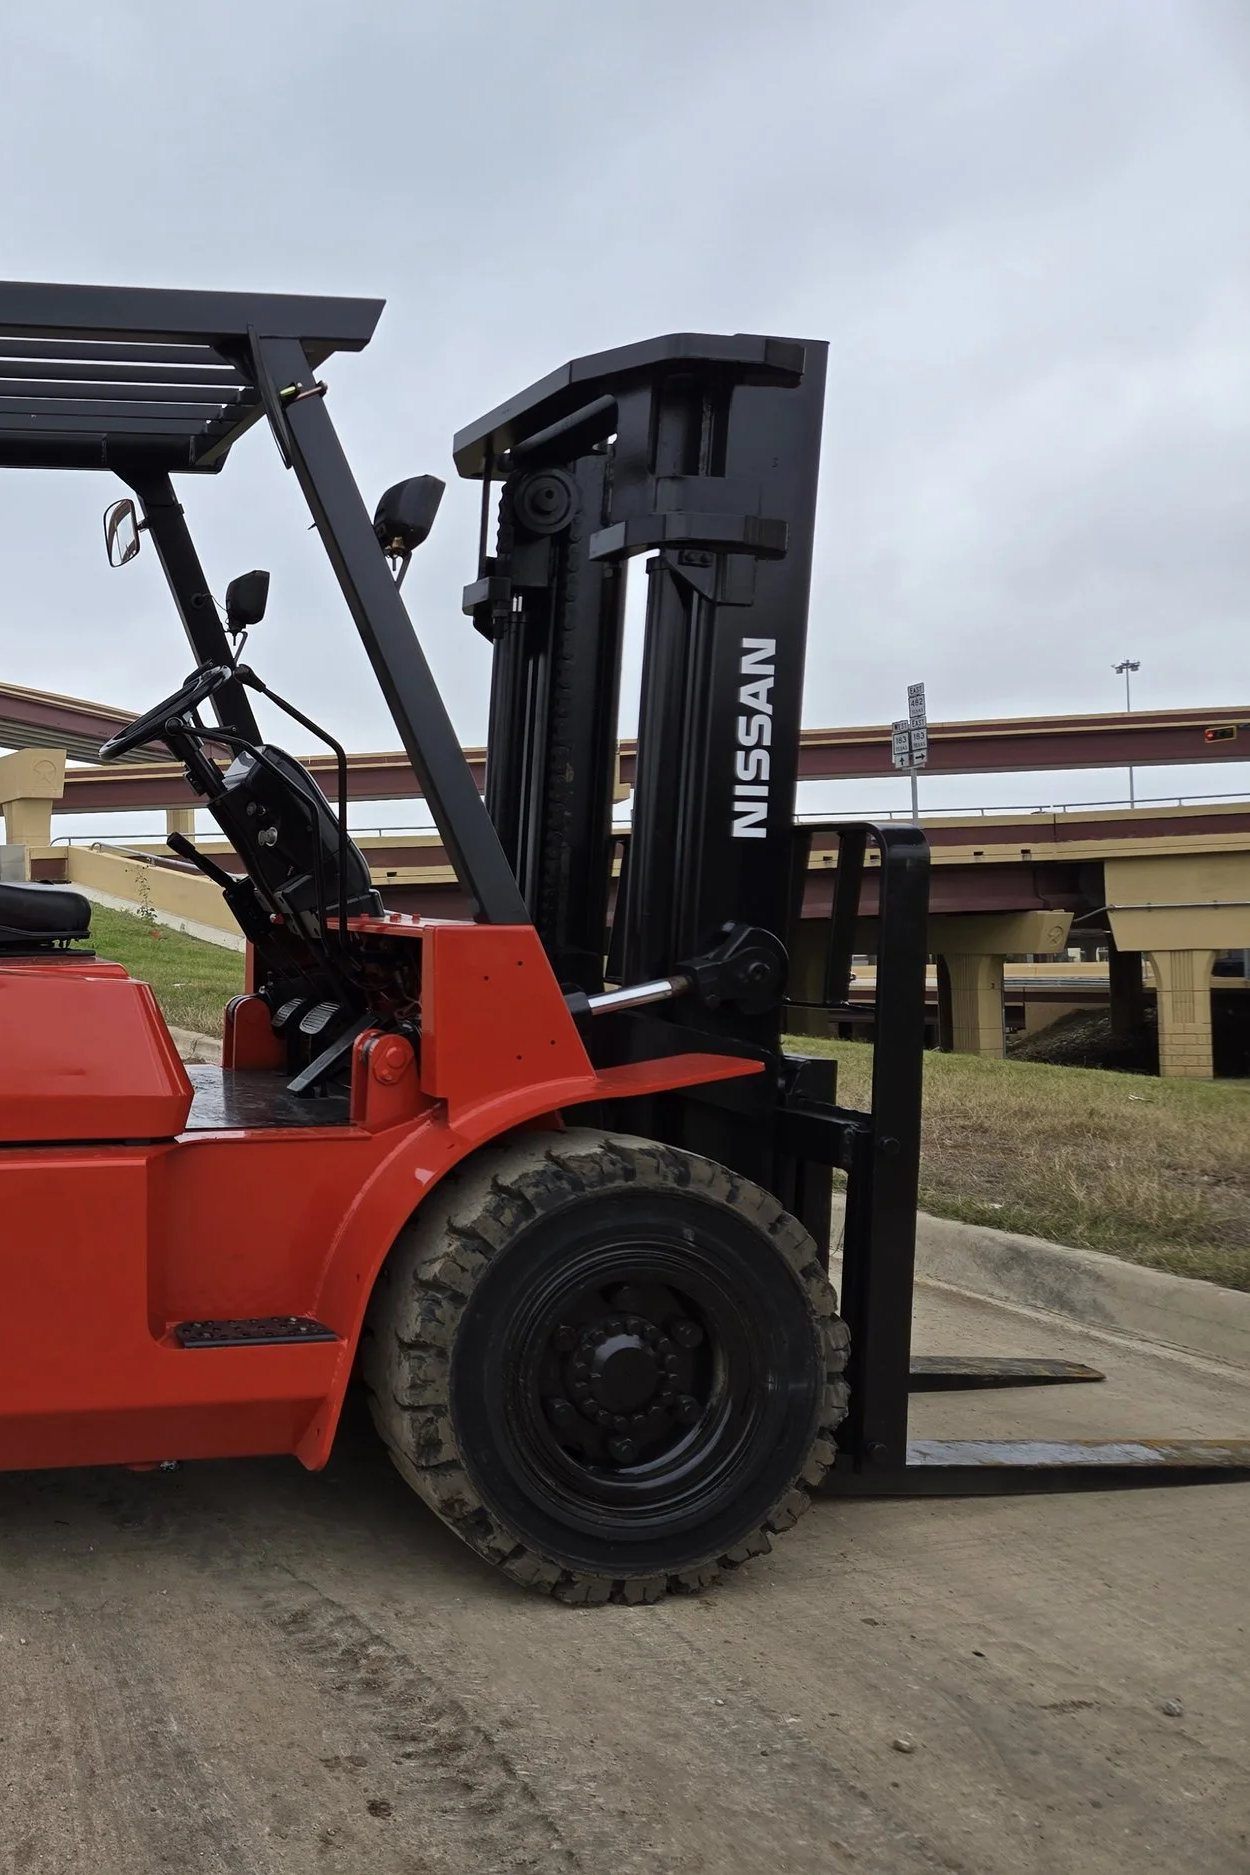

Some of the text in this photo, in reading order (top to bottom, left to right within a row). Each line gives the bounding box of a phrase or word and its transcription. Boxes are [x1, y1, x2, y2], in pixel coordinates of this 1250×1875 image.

[910, 686, 922, 695] EAST
[894, 722, 907, 731] WEST
[912, 719, 924, 728] EAST
[731, 637, 776, 838] NISSAN
[896, 736, 907, 744] 183
[913, 732, 925, 741] 183
